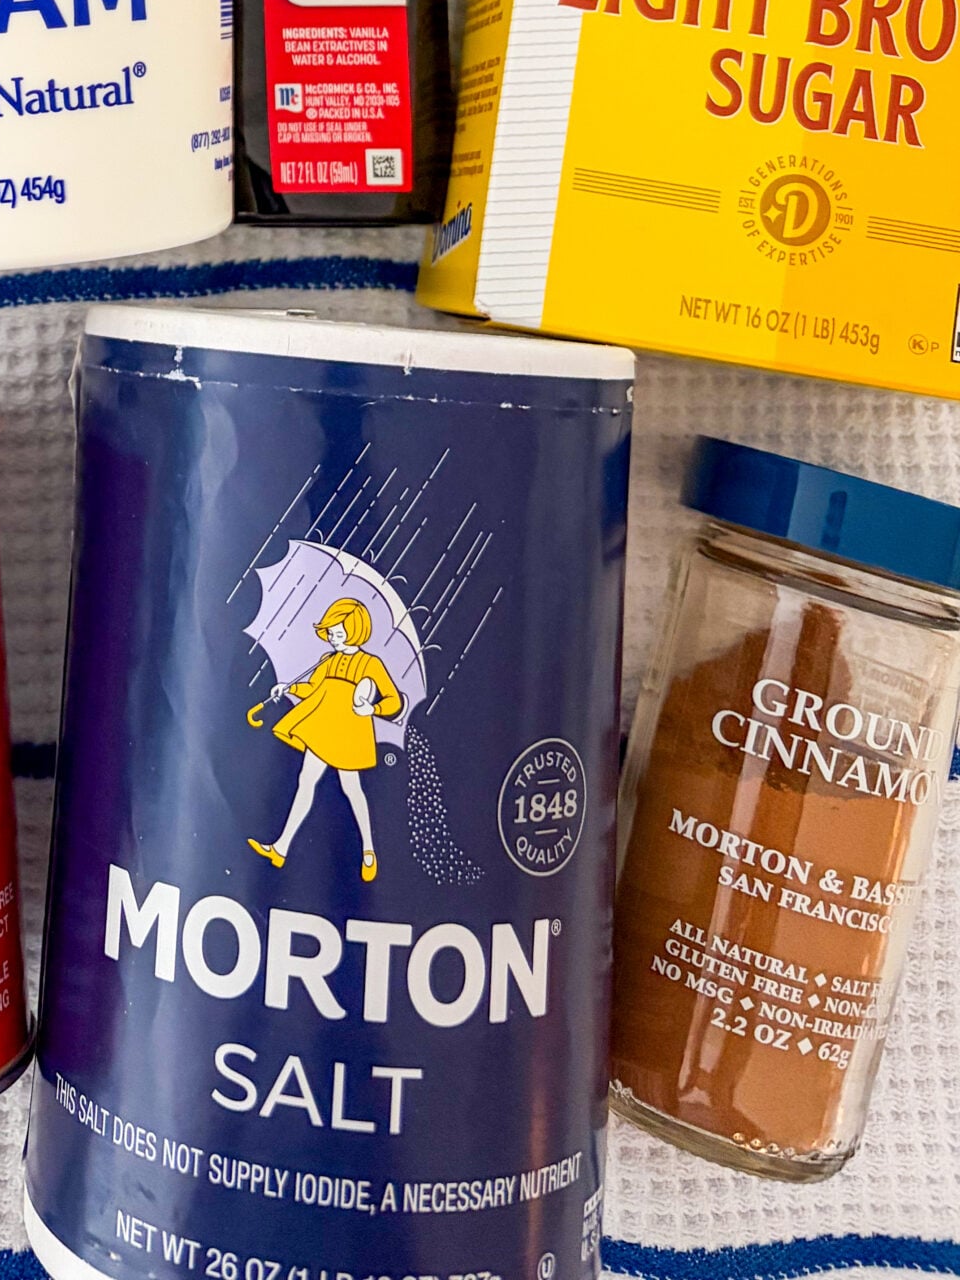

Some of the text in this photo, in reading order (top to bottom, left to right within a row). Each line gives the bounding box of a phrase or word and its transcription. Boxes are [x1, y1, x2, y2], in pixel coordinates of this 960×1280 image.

[283, 27, 389, 39] INGREDIENTS: VANILLA
[285, 40, 388, 52] BEAN EXTRACTIVES IN
[292, 54, 381, 66] WATER & ALCOHOL.
[705, 48, 925, 148] SUGAR
[20, 175, 66, 205] 454g
[748, 154, 848, 201] GENERATIONS
[742, 220, 842, 266] OF EXPERTISE
[680, 295, 880, 355] NET WT 16 OZ (1 LB) 453g
[752, 678, 944, 762] GROUND
[514, 751, 577, 788] TRUSTED
[513, 789, 578, 824] 1848
[515, 827, 573, 865] QUALITY
[104, 863, 550, 1028] MORTON
[669, 918, 707, 947] ALL
[710, 935, 809, 985] NATURAL
[831, 976, 870, 997] SALT
[710, 1007, 852, 1070] 2.2 OZ 62g
[211, 1042, 424, 1136] SALT
[55, 1072, 582, 1215] THIS SALT DOES NOT SUPPLY IODIDE, A NECESSARY NUTRIENT
[115, 1210, 158, 1253] NET
[162, 1230, 202, 1270] WT
[206, 1247, 238, 1280] 26
